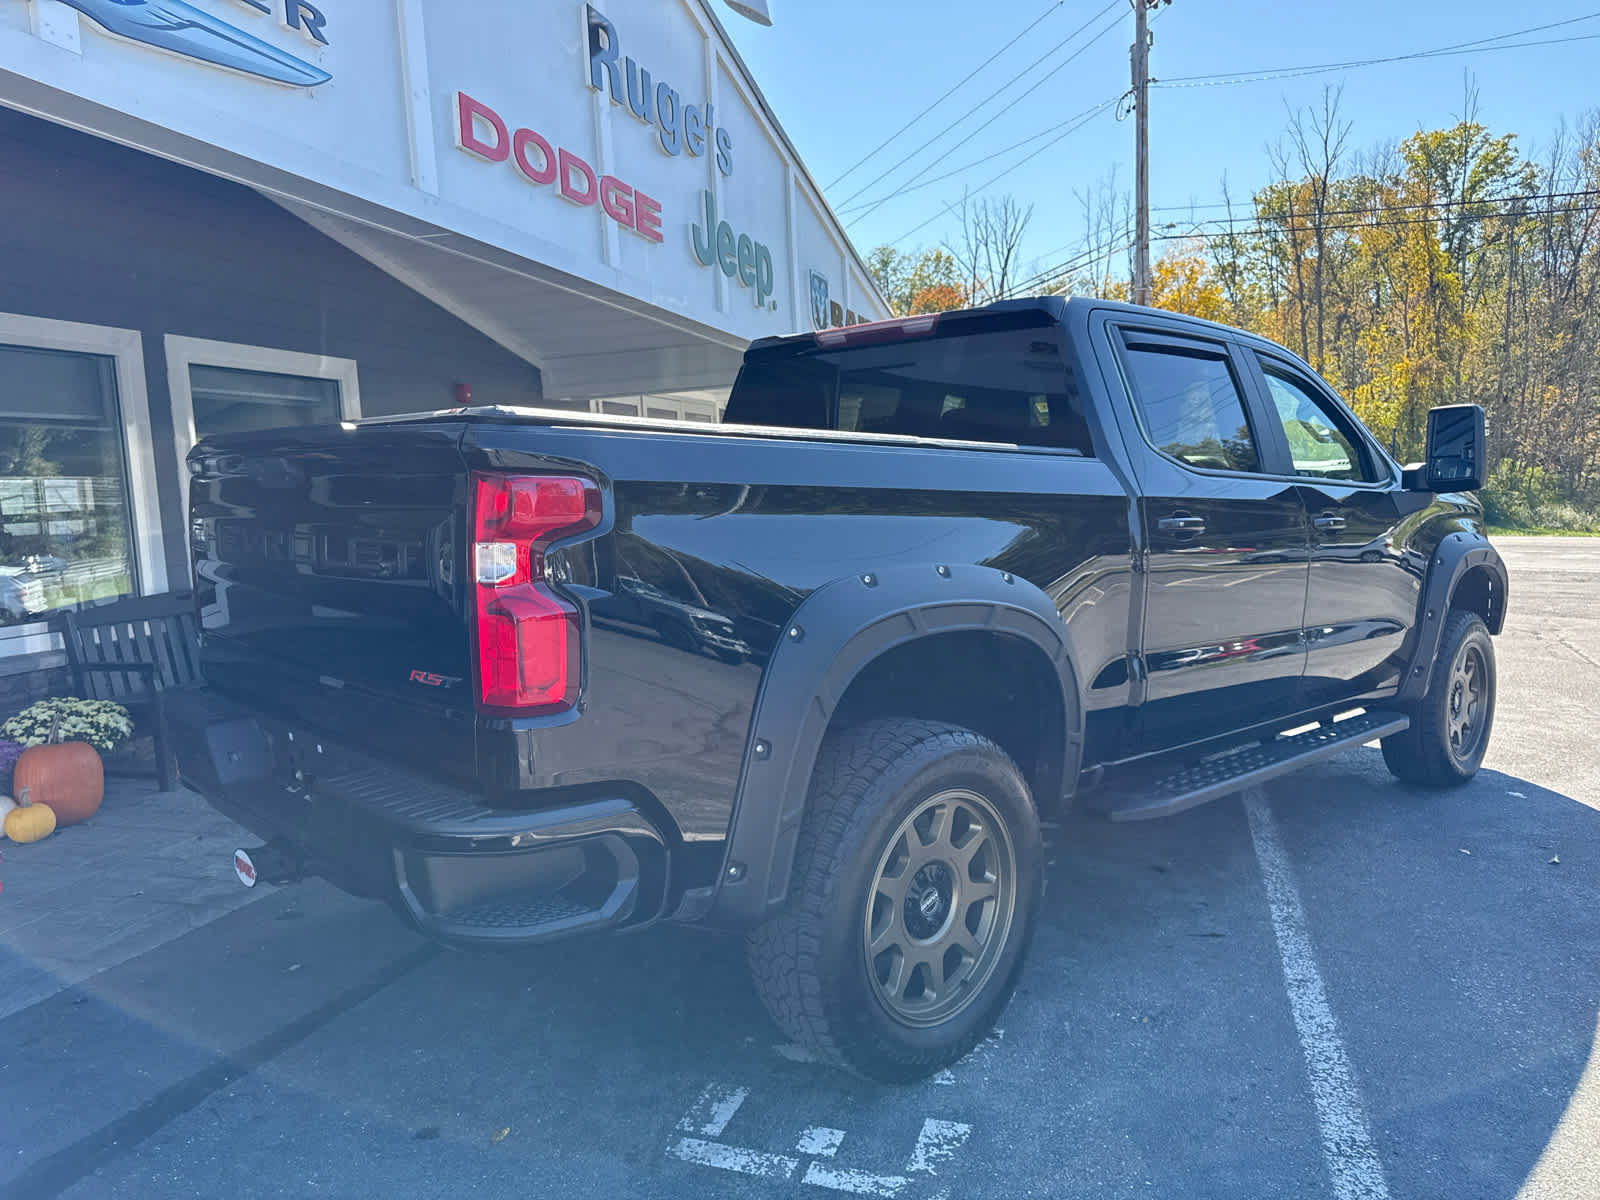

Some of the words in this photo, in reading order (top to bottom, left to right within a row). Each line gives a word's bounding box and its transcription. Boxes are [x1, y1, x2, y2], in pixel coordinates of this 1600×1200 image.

[243, 0, 329, 46] R
[586, 3, 733, 177] Ruge's
[457, 90, 664, 243] DODGE
[408, 669, 463, 689] RST
